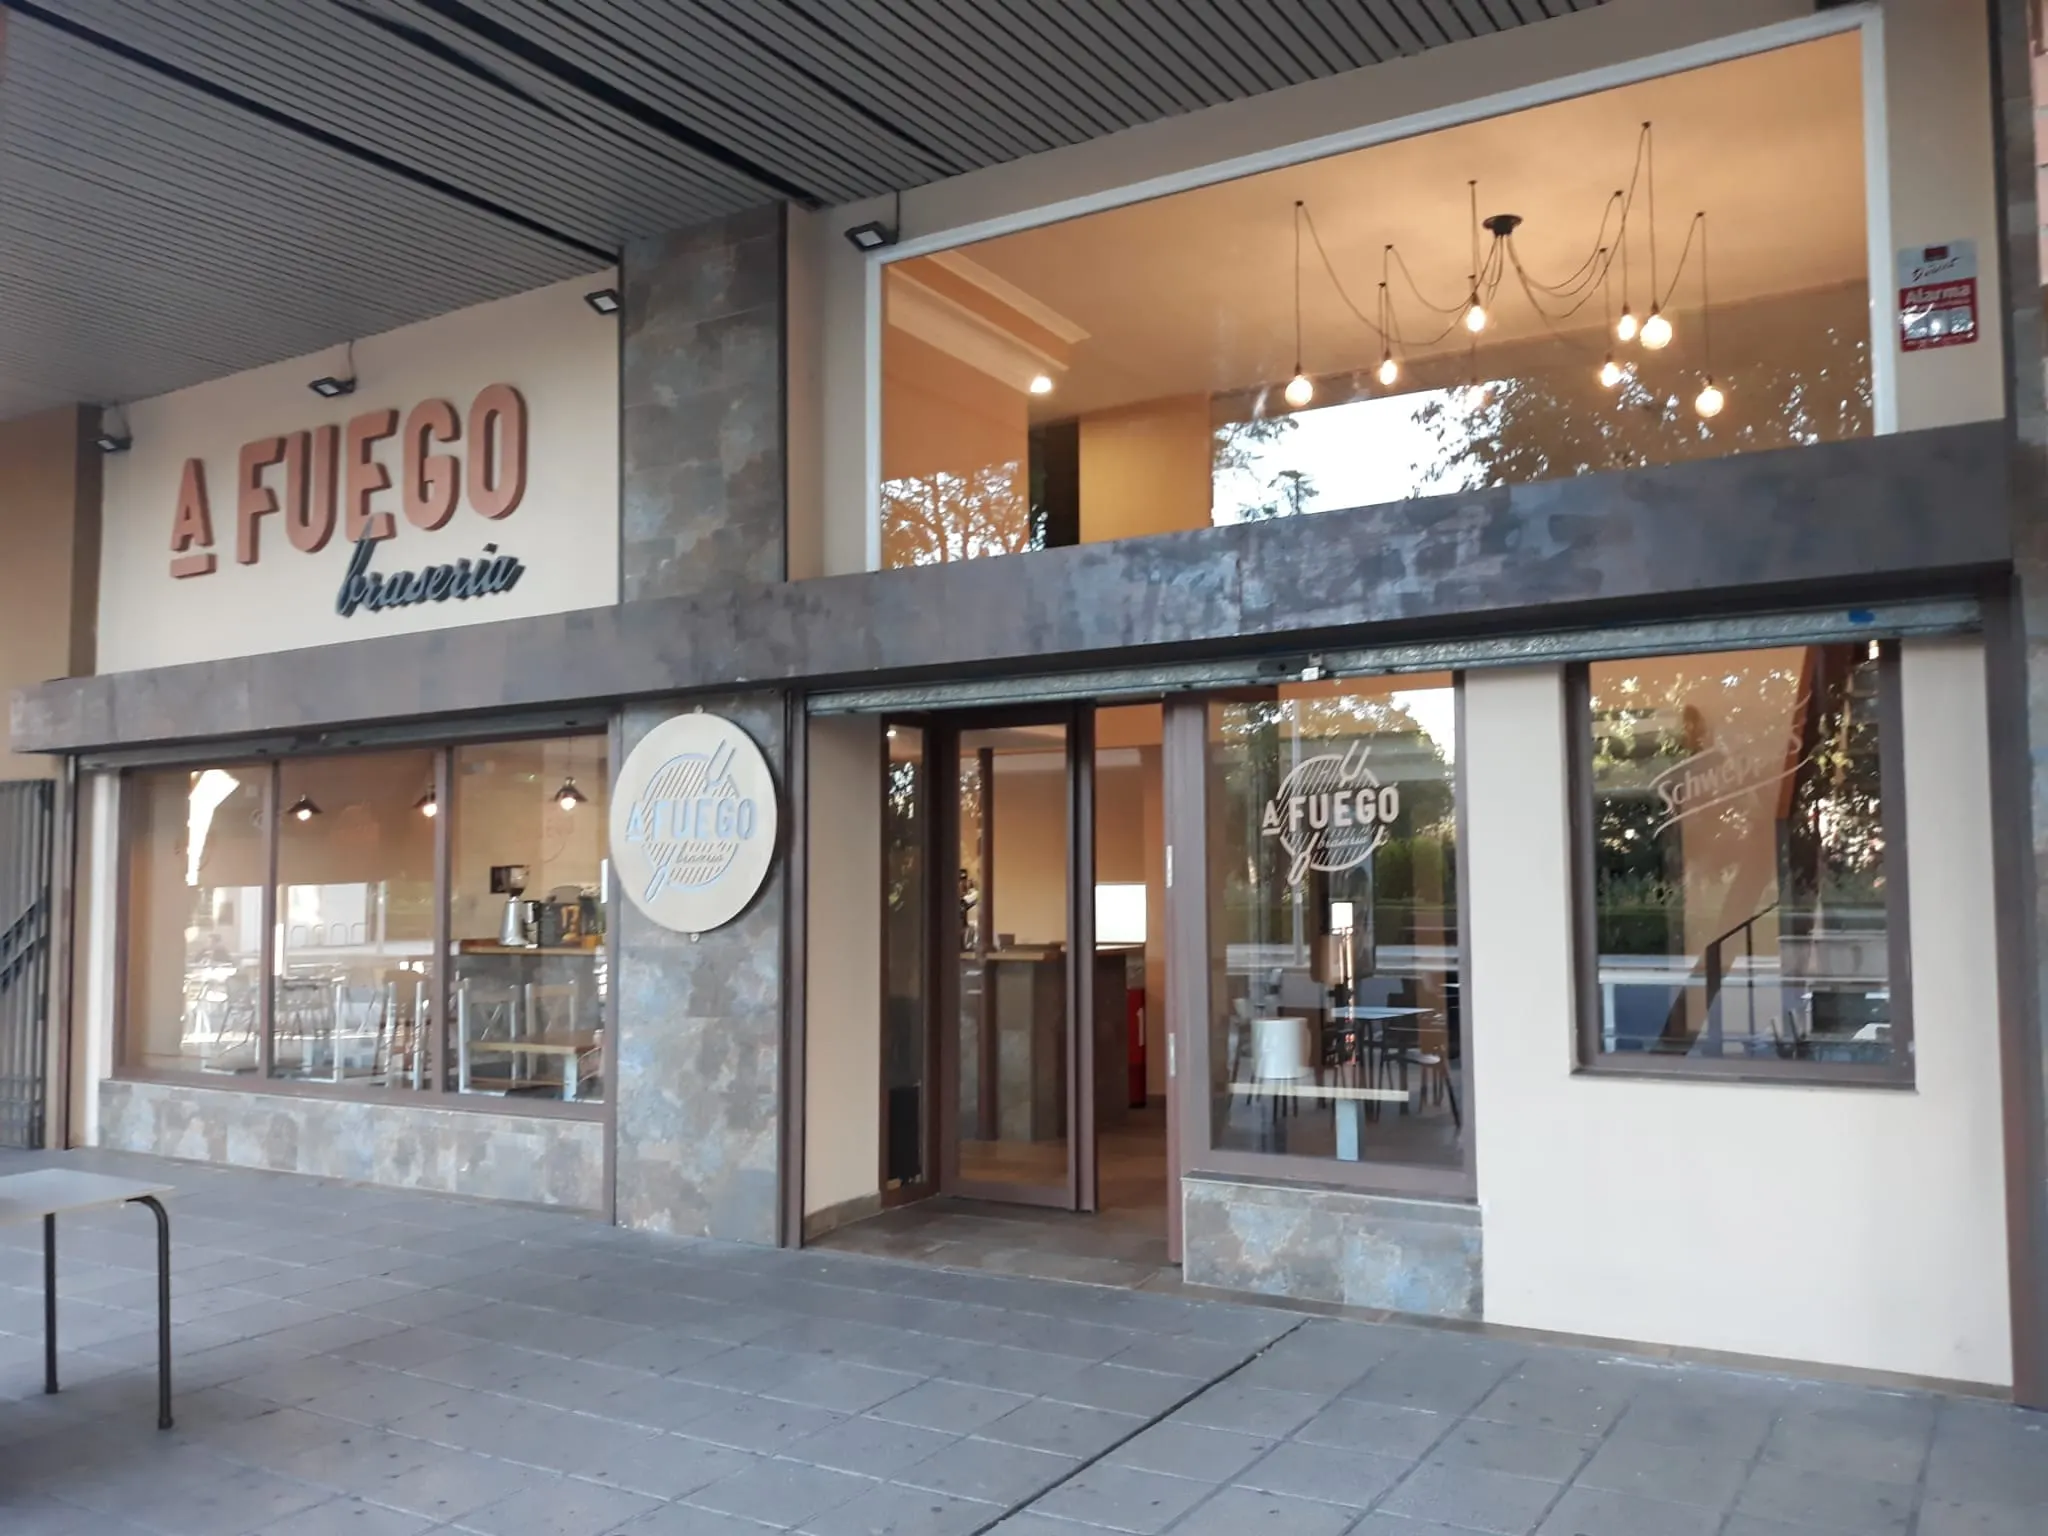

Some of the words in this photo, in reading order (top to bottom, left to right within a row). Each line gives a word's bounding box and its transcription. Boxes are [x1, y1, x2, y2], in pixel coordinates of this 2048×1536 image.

[170, 457, 217, 578] A
[236, 383, 529, 564] FUEGO
[625, 799, 644, 842] A
[652, 798, 758, 841] FUEGO
[1262, 800, 1281, 835] A
[1289, 786, 1400, 832] FUEGO
